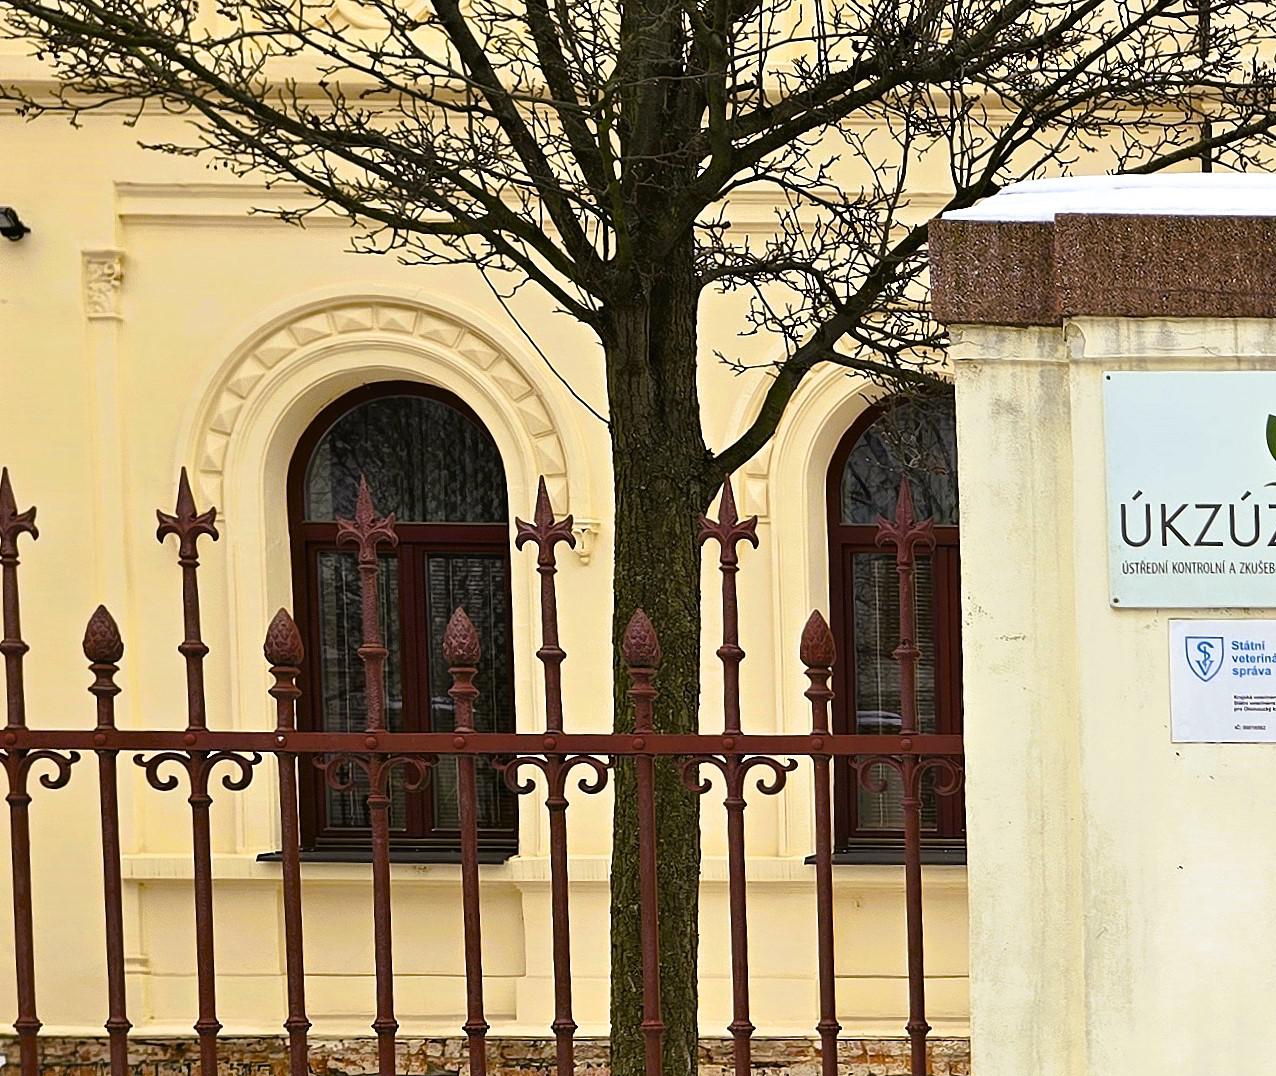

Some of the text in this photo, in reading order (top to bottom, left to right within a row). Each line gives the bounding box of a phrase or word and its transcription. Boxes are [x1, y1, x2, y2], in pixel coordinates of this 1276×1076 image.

[1122, 560, 1169, 575] ÚSTŘEDNÍ
[1172, 560, 1226, 574] KONTROLNÍ
[1229, 562, 1237, 574] A
[1231, 640, 1265, 651] Státní
[1232, 666, 1272, 677] správa
